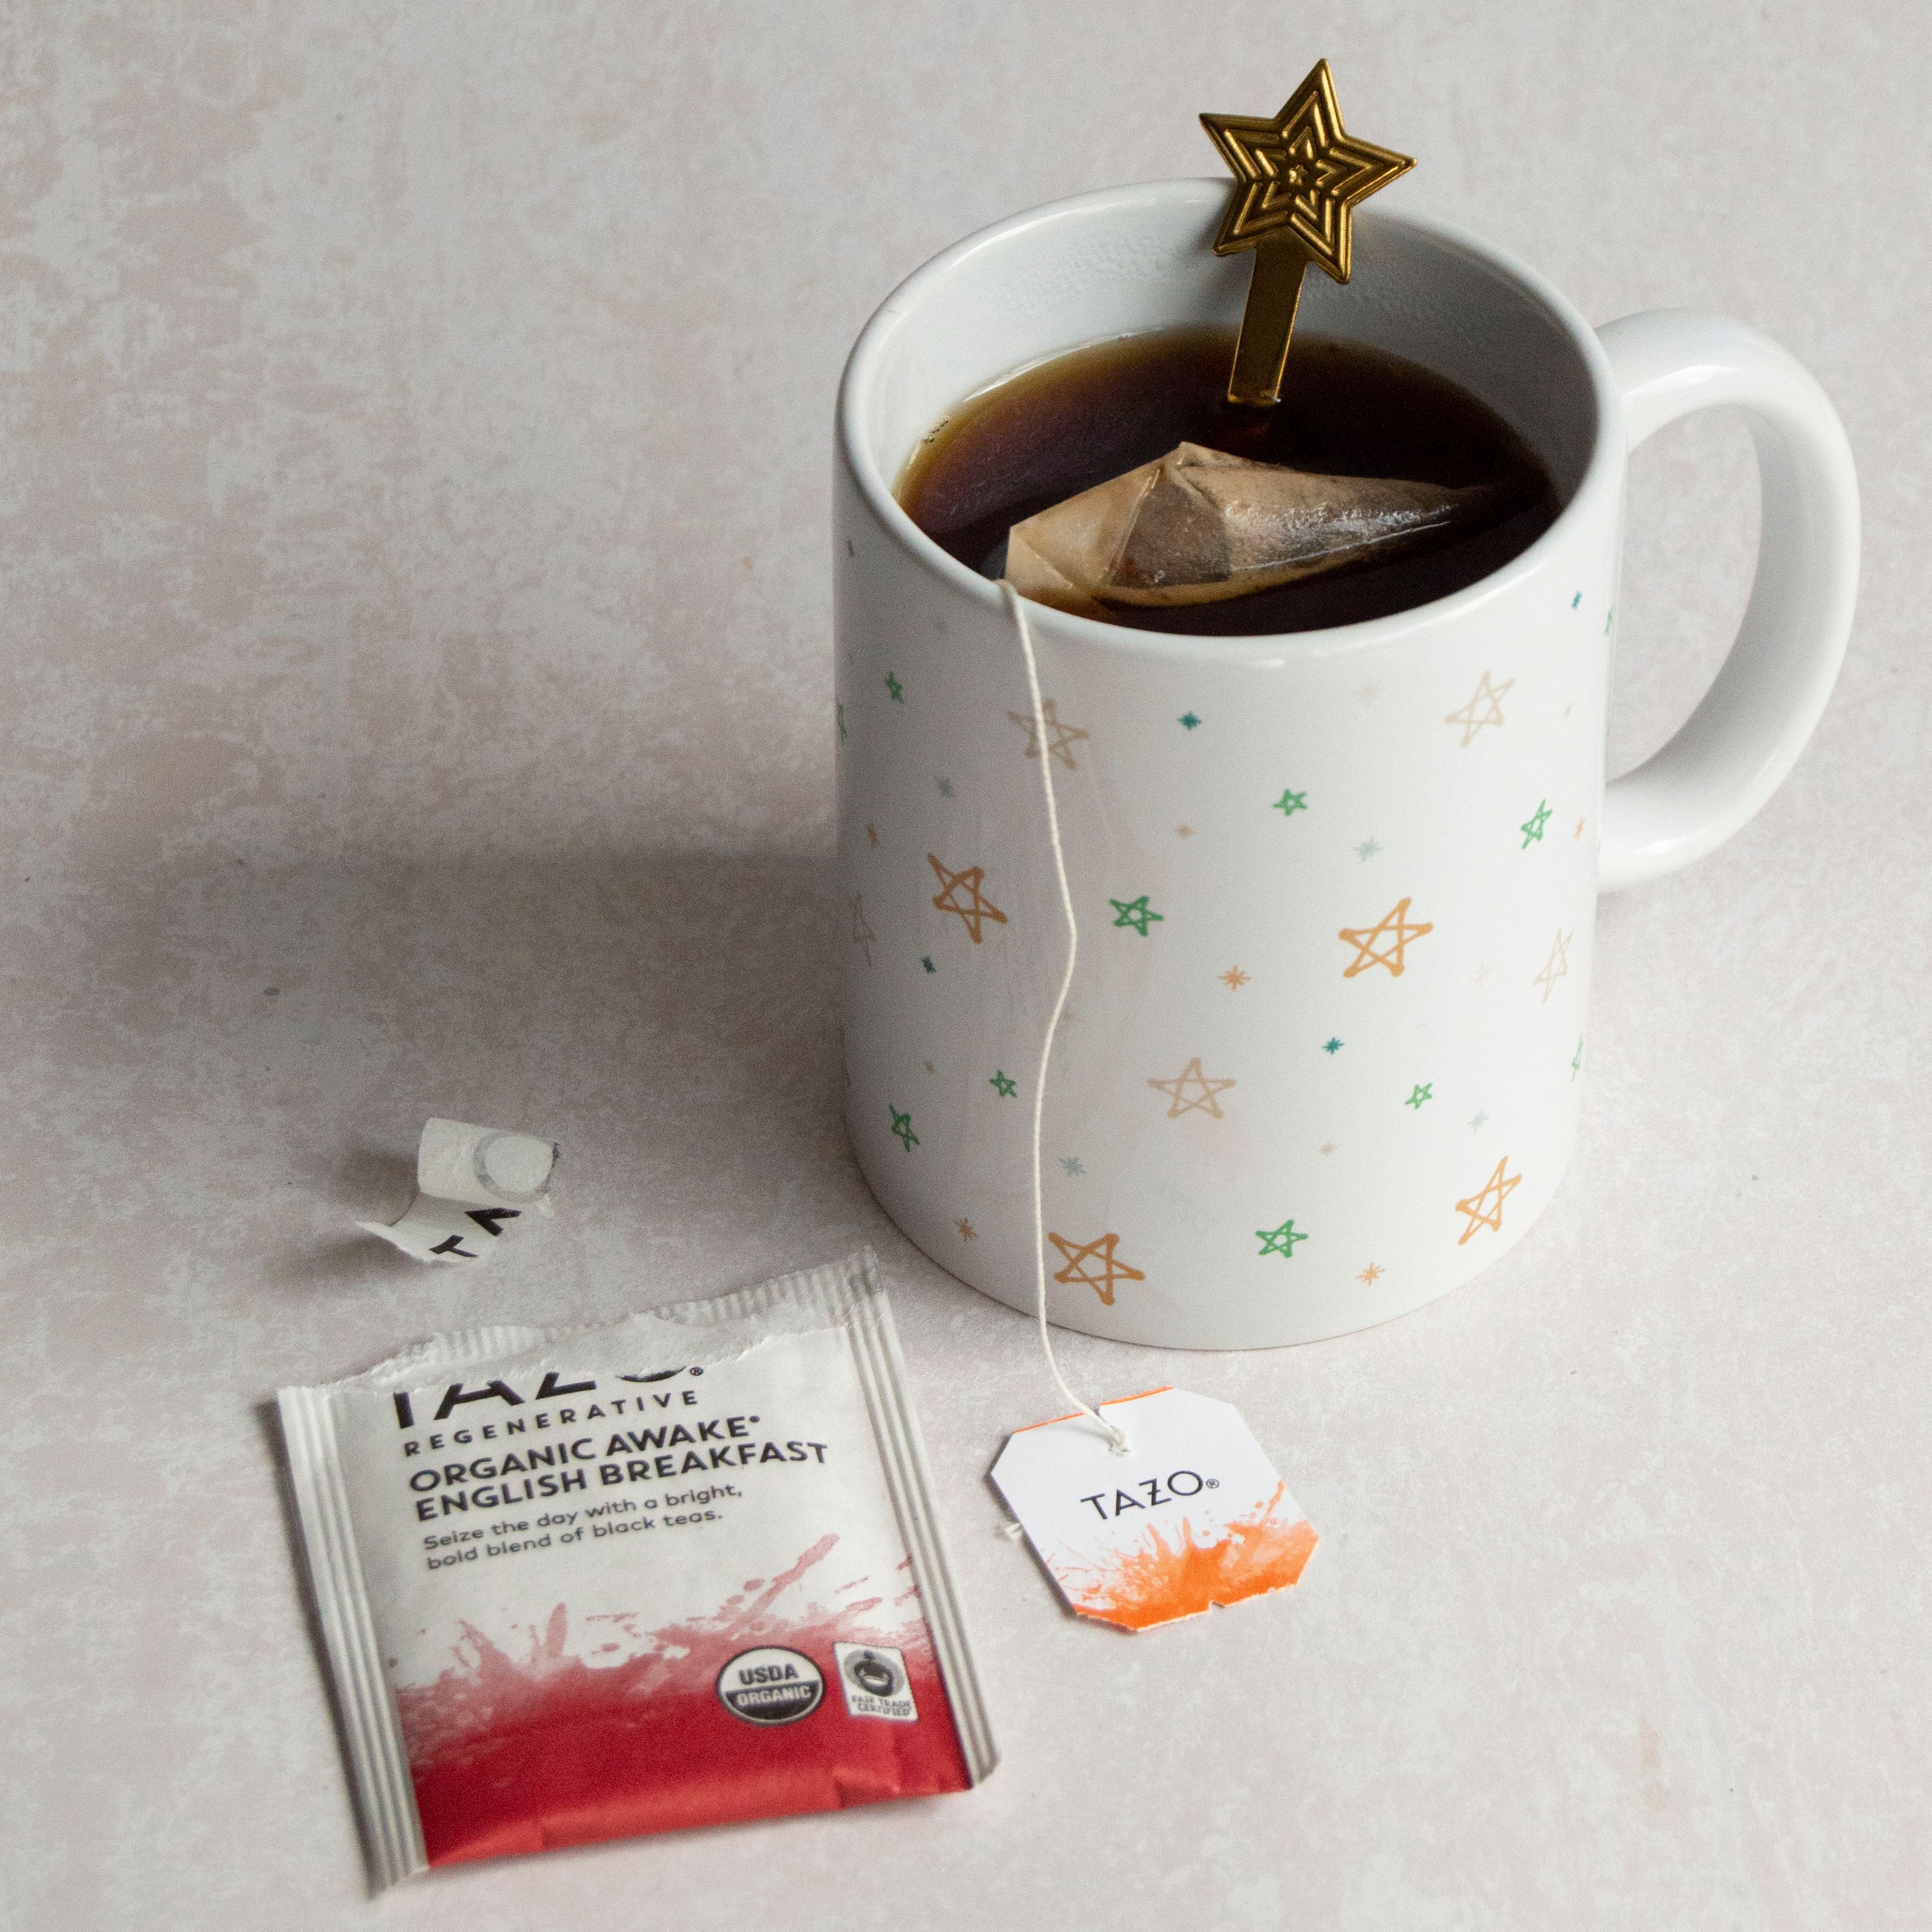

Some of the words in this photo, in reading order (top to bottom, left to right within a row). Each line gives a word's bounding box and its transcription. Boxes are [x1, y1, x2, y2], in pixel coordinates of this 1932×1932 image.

[404, 1389, 698, 1457] REGENERATIVE
[410, 1438, 597, 1492] ORGANIC
[416, 1468, 587, 1521] ENGLISH
[600, 1441, 828, 1485] BREAKFAST
[423, 1529, 484, 1550] Seize
[491, 1521, 529, 1535] the
[537, 1512, 578, 1526] day
[585, 1501, 637, 1518] with
[645, 1499, 658, 1509] a
[665, 1483, 742, 1507] bright,
[428, 1546, 478, 1570] bold
[486, 1533, 551, 1556] blend
[561, 1527, 584, 1543] of
[593, 1517, 655, 1538] black
[664, 1508, 723, 1526] teas.
[736, 1685, 812, 1707] ORGANIC
[739, 1663, 799, 1685] USDA
